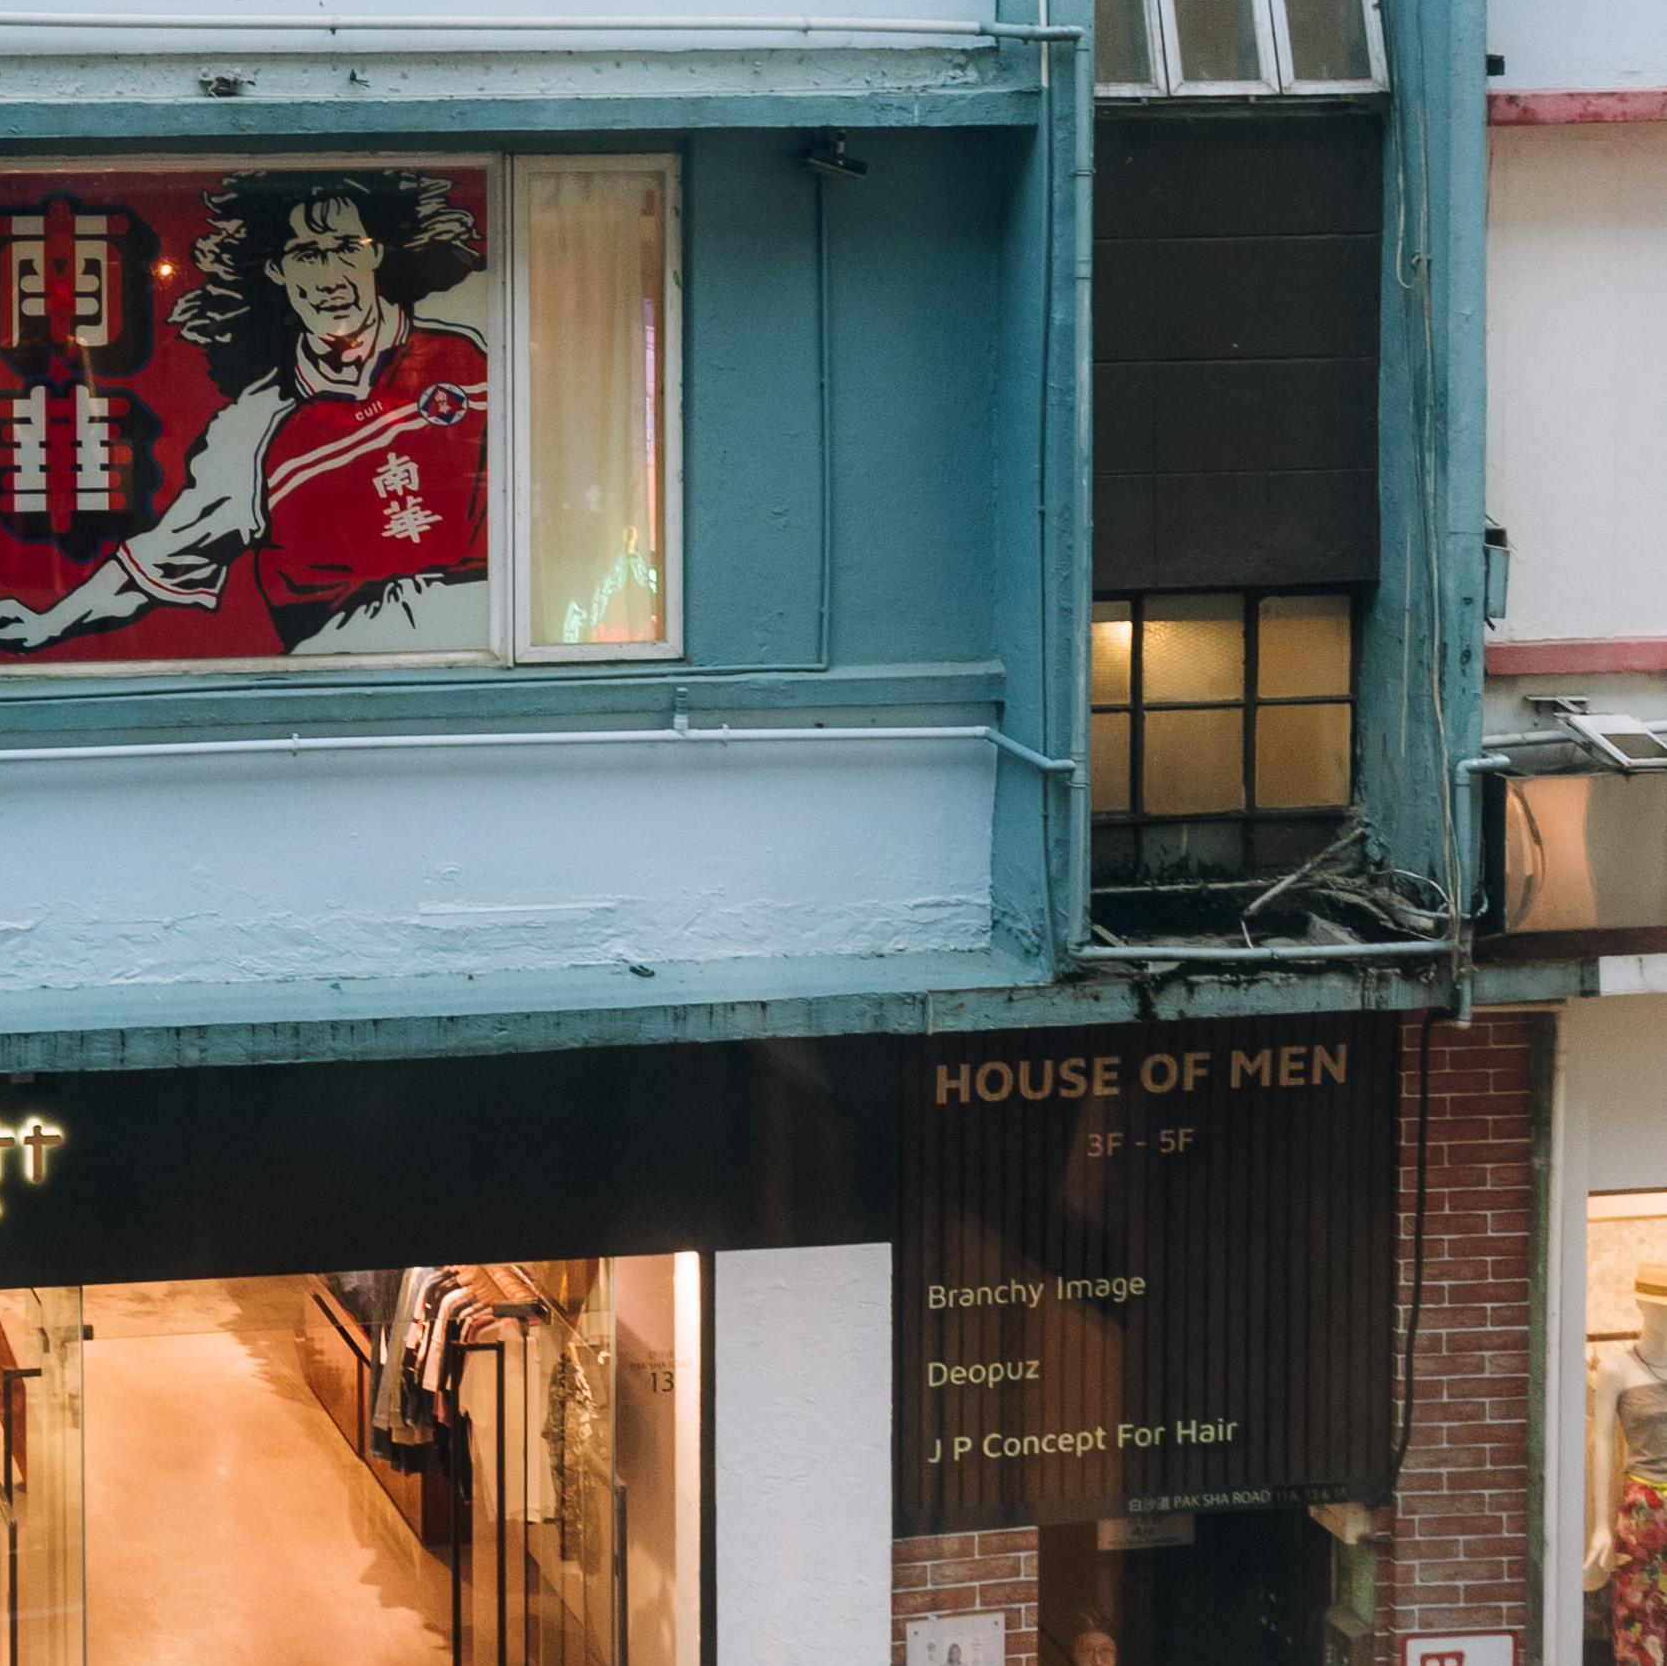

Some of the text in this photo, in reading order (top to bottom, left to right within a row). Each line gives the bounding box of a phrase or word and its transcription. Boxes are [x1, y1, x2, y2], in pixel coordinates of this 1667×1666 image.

[354, 400, 384, 422] cult
[372, 452, 444, 543] 南華
[935, 1043, 1348, 1105] HOUSE OF MEN
[1086, 1132, 1124, 1158] 3F
[1159, 1127, 1195, 1154] 5F
[928, 1276, 1146, 1309] Branchy Image
[651, 1371, 674, 1393] 13
[928, 1360, 1040, 1389] Deopuz
[928, 1418, 1238, 1464] J P Concept For Hair
[1174, 1496, 1200, 1510] PAK
[1203, 1493, 1229, 1507] SHA
[1233, 1490, 1271, 1504] ROAD
